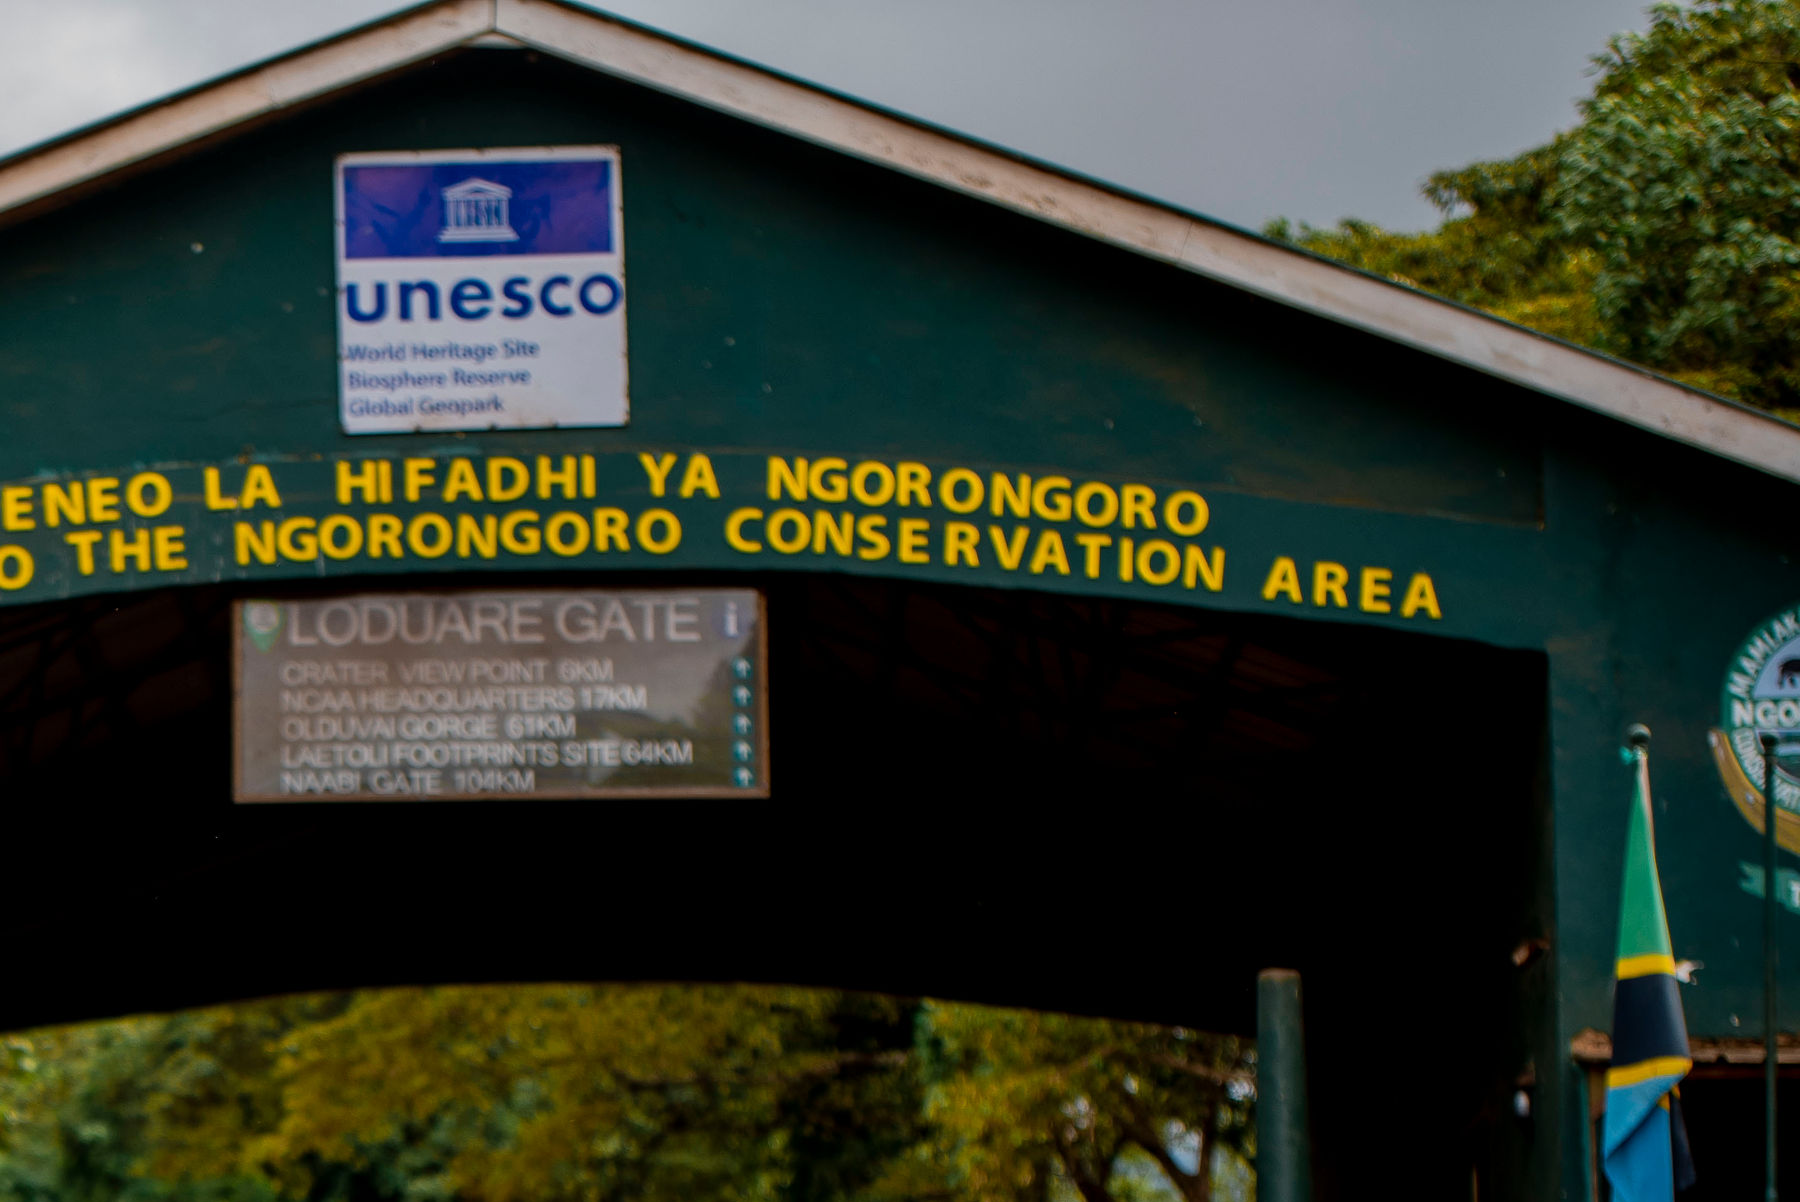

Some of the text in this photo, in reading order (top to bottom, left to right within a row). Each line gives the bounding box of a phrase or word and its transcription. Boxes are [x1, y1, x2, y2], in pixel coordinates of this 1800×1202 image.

[345, 273, 622, 322] unesco
[346, 340, 540, 362] World Heritage Site
[349, 368, 532, 392] Biosphere Reserve
[350, 396, 504, 416] Global Geopark
[3, 472, 173, 532] ENEO
[203, 464, 282, 511] LA
[335, 453, 597, 503] HIFADHI
[638, 452, 721, 499] YA
[766, 456, 1210, 537] NGORONGORO
[66, 525, 189, 577] THE
[234, 507, 683, 565] NGORONGORO
[724, 506, 1226, 592] CONSERVATION
[1261, 556, 1443, 620] AREA
[287, 596, 701, 646] LODUARE GATE
[280, 660, 388, 687] CRATER
[358, 685, 575, 712] HEADQUARTERS
[580, 684, 648, 710] 17KM
[280, 713, 577, 742] OLDUVAI GORGE 61KM
[391, 742, 558, 768] FOOTPRINTS
[561, 740, 620, 767] SITE
[621, 739, 694, 767] 64KM
[280, 769, 536, 795] NAABI GATE 104KM
